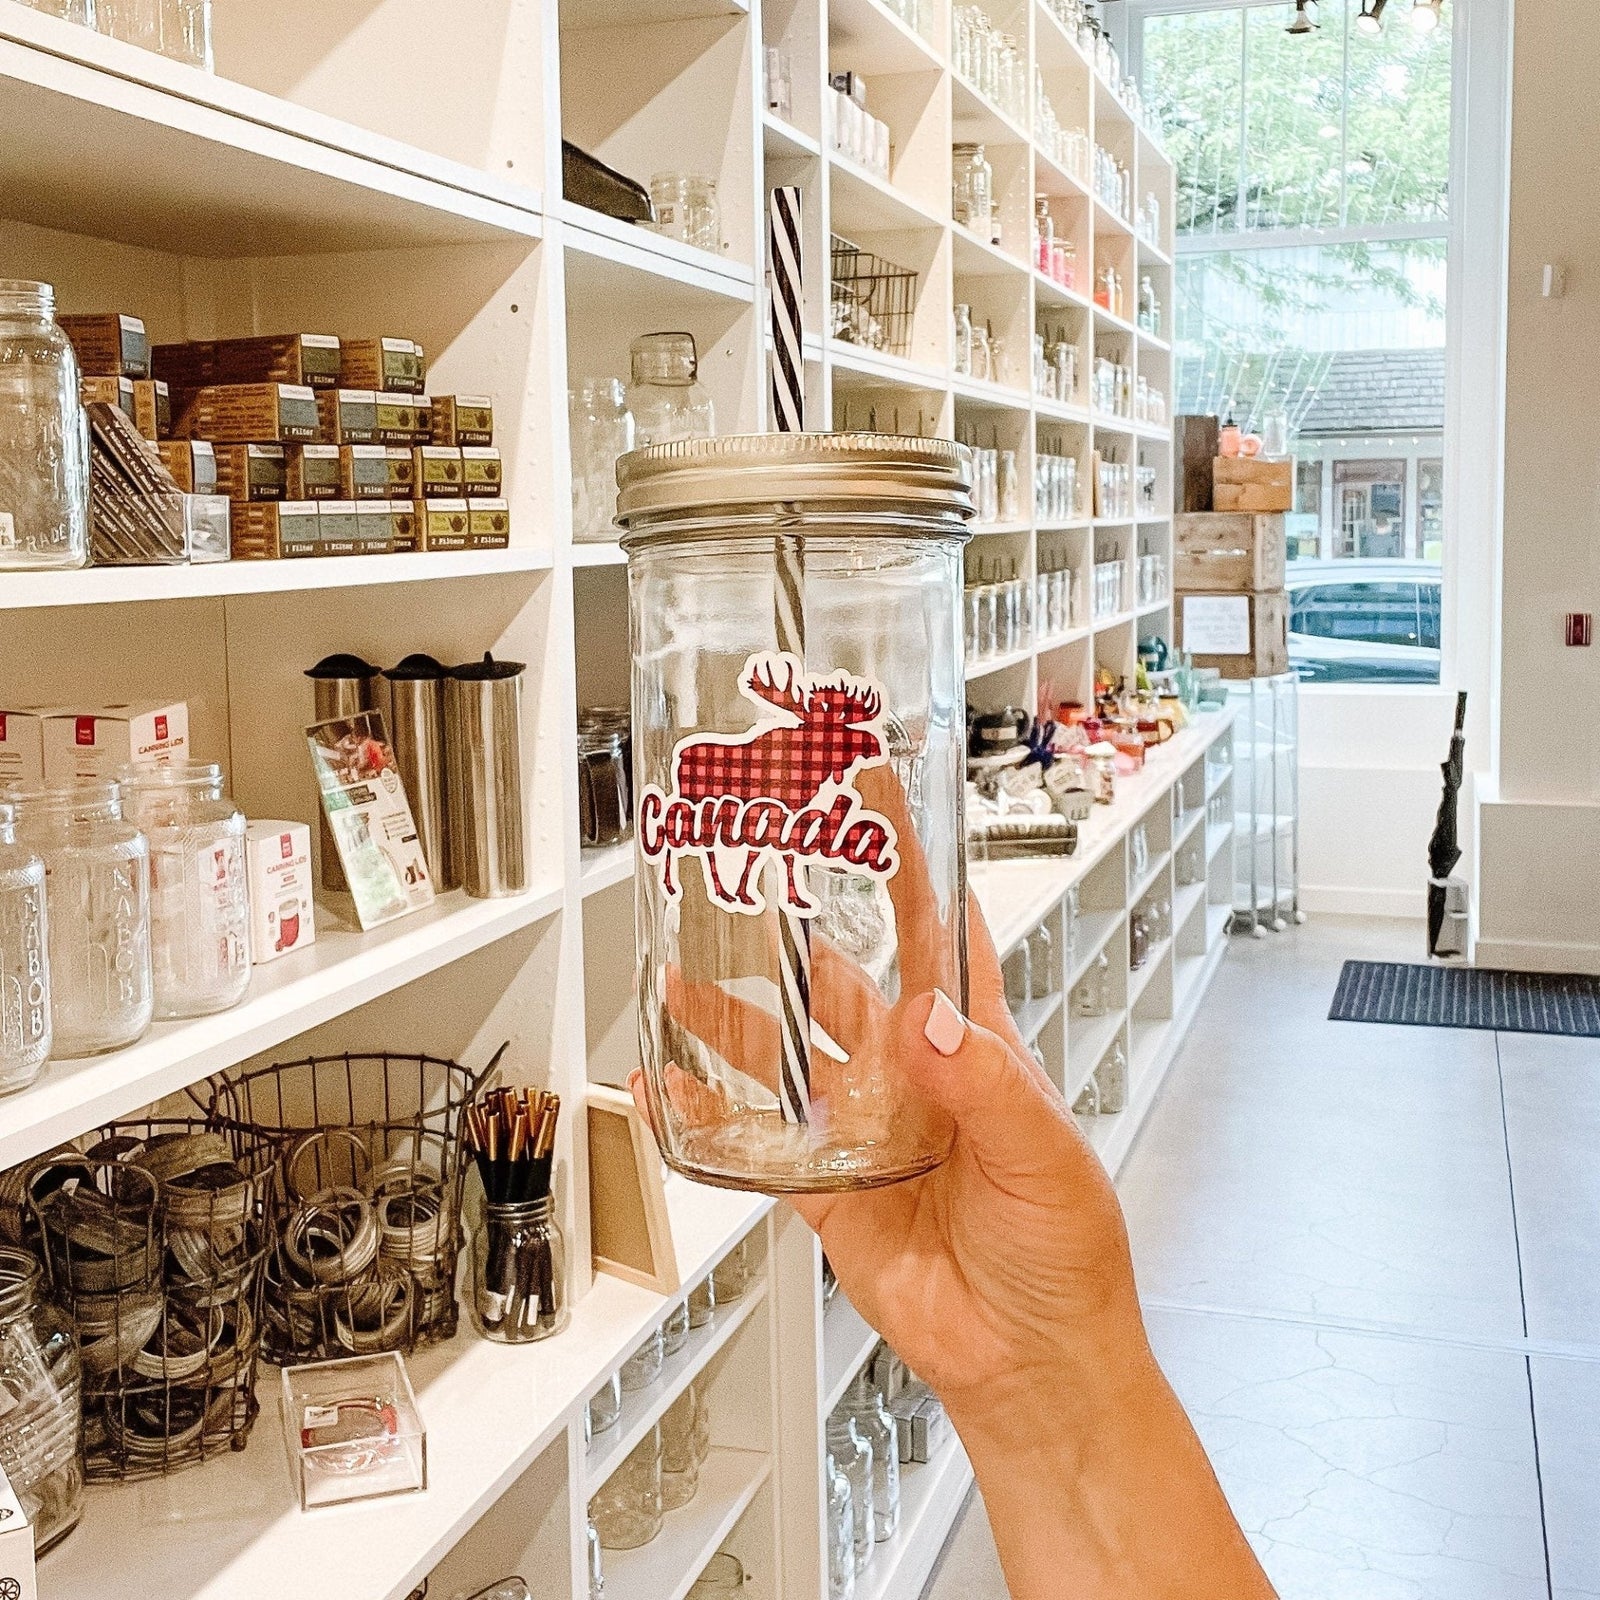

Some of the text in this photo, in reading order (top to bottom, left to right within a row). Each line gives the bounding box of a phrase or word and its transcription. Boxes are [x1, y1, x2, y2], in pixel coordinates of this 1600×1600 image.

[292, 544, 314, 552] Filter
[266, 855, 307, 874] CANNING LIDS
[640, 793, 893, 873] Canada
[24, 888, 44, 1037] NABOB
[113, 868, 134, 1004] NABOB
